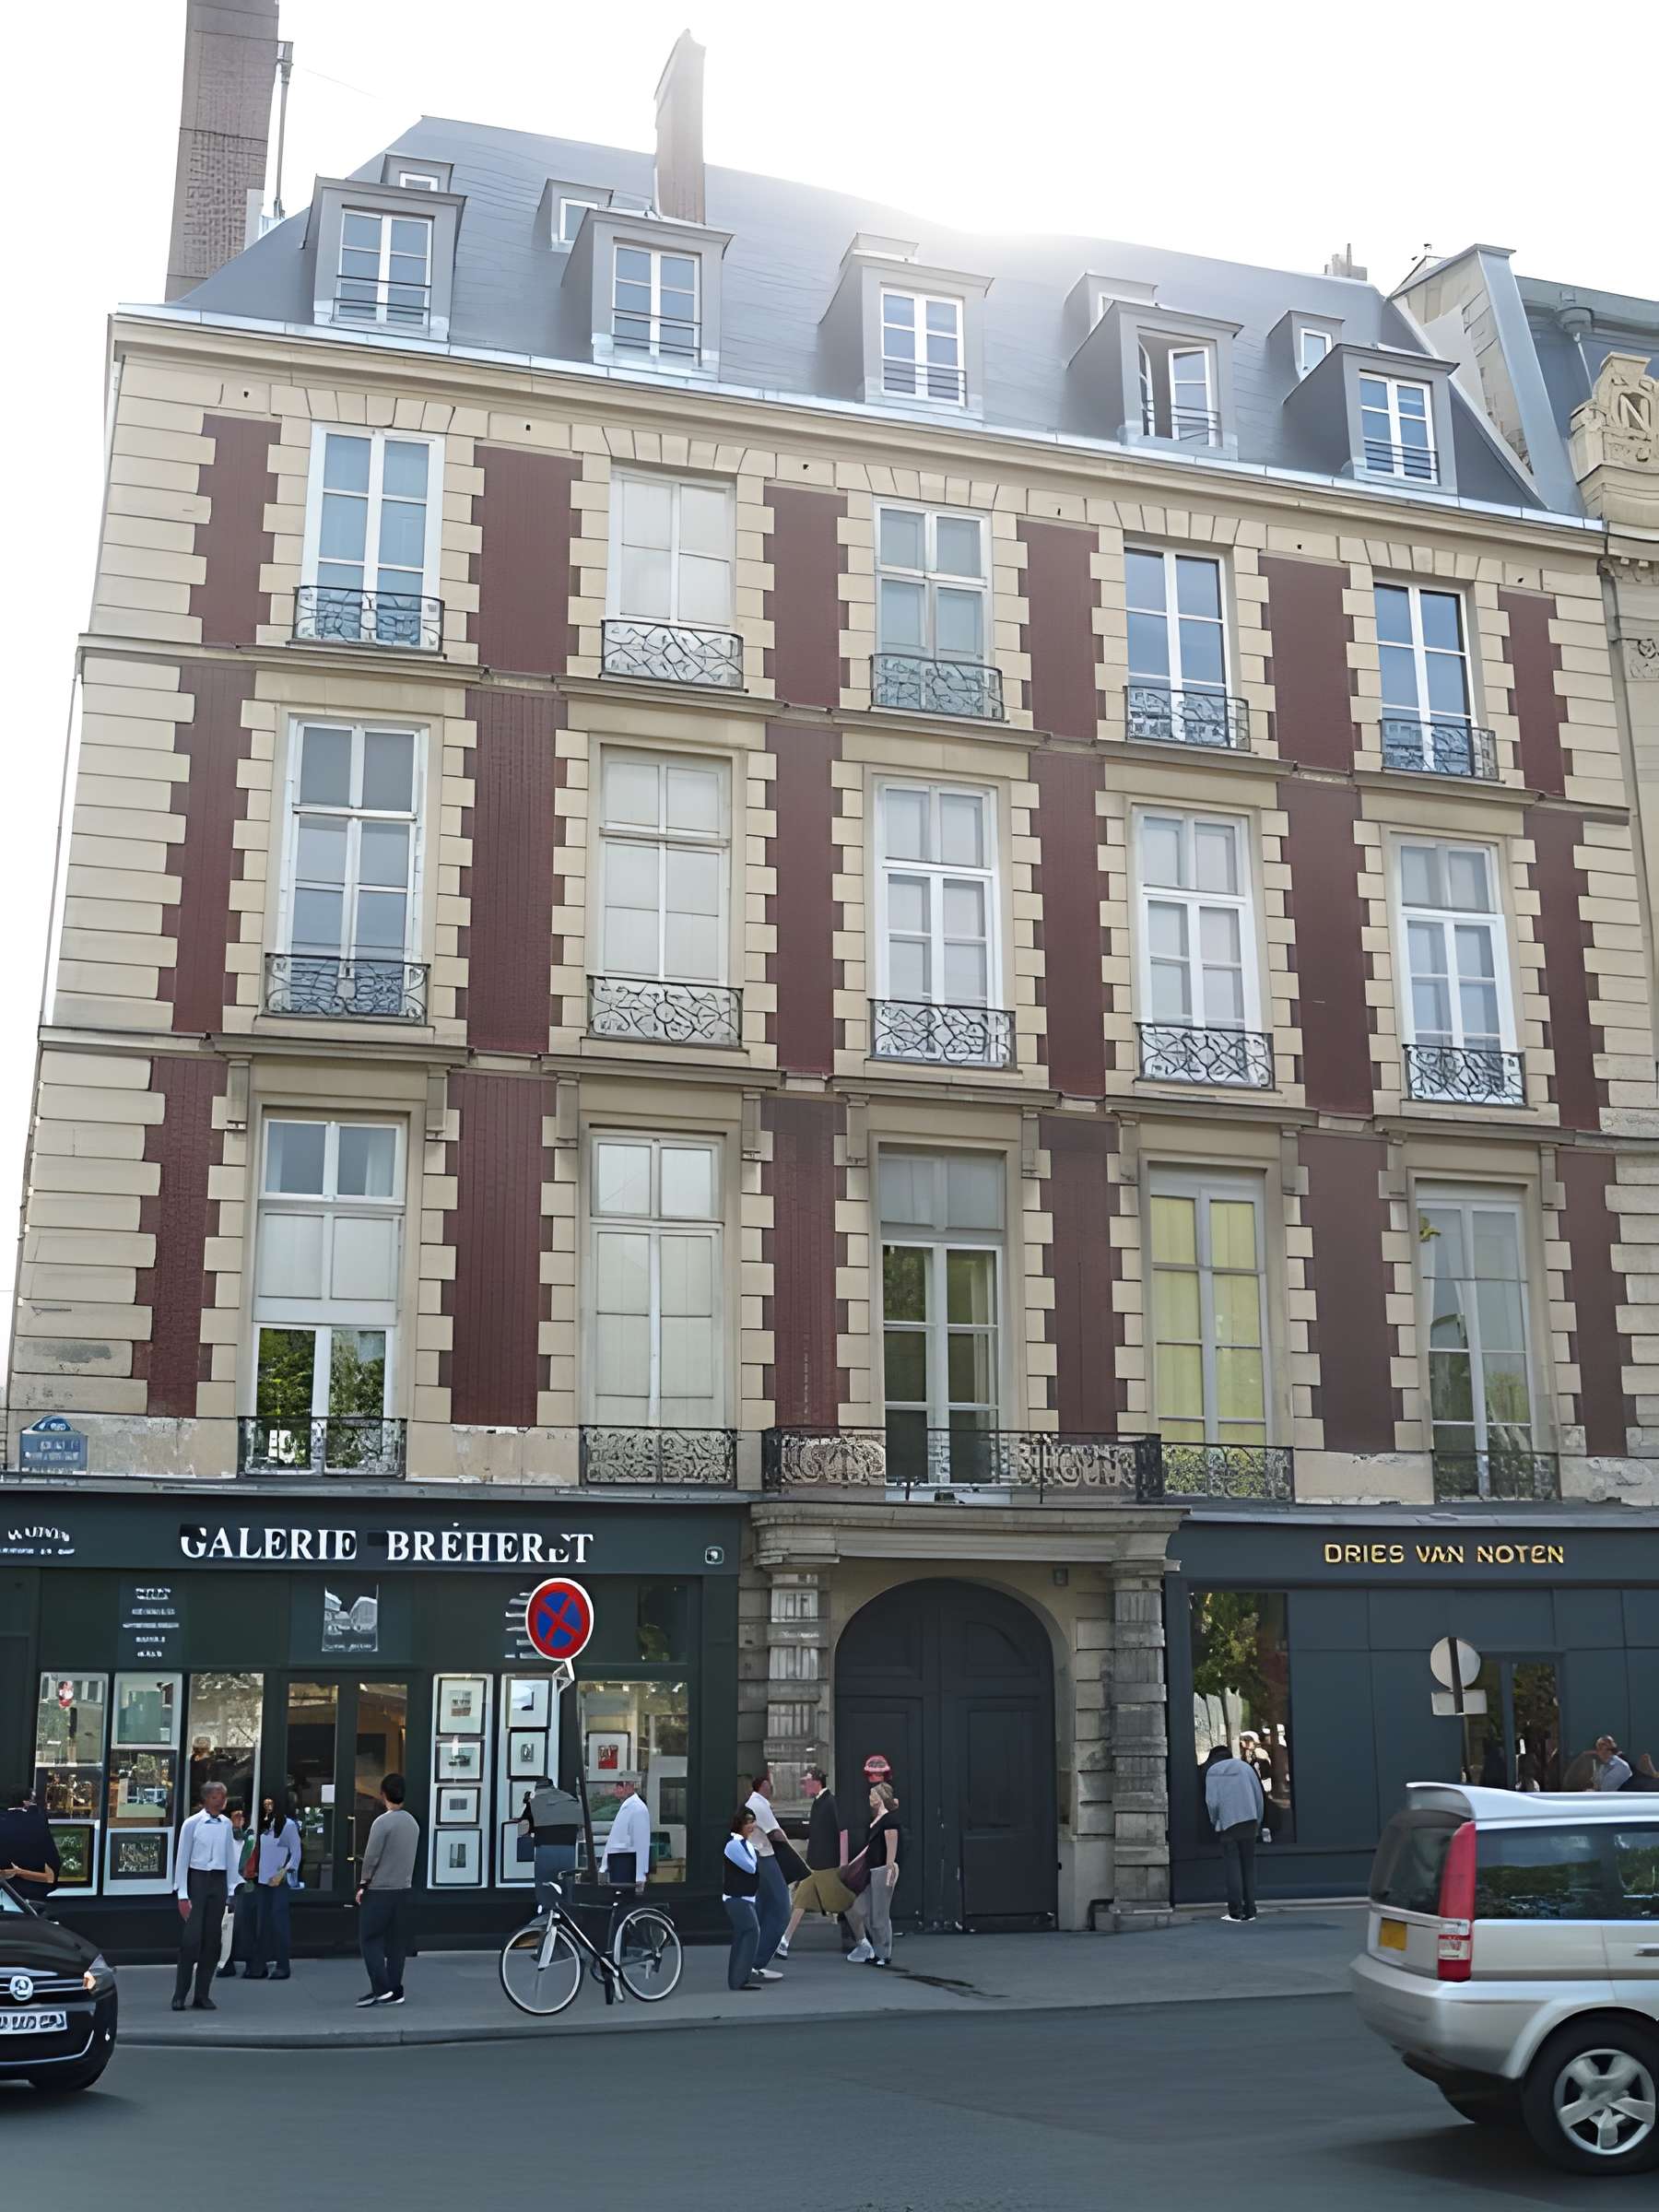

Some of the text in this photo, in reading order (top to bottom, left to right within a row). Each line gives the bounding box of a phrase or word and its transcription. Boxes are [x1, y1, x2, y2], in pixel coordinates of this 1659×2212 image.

[180, 1526, 358, 1560] GALERIE
[1324, 1543, 1565, 1565] DRIES VAN NOTEN
